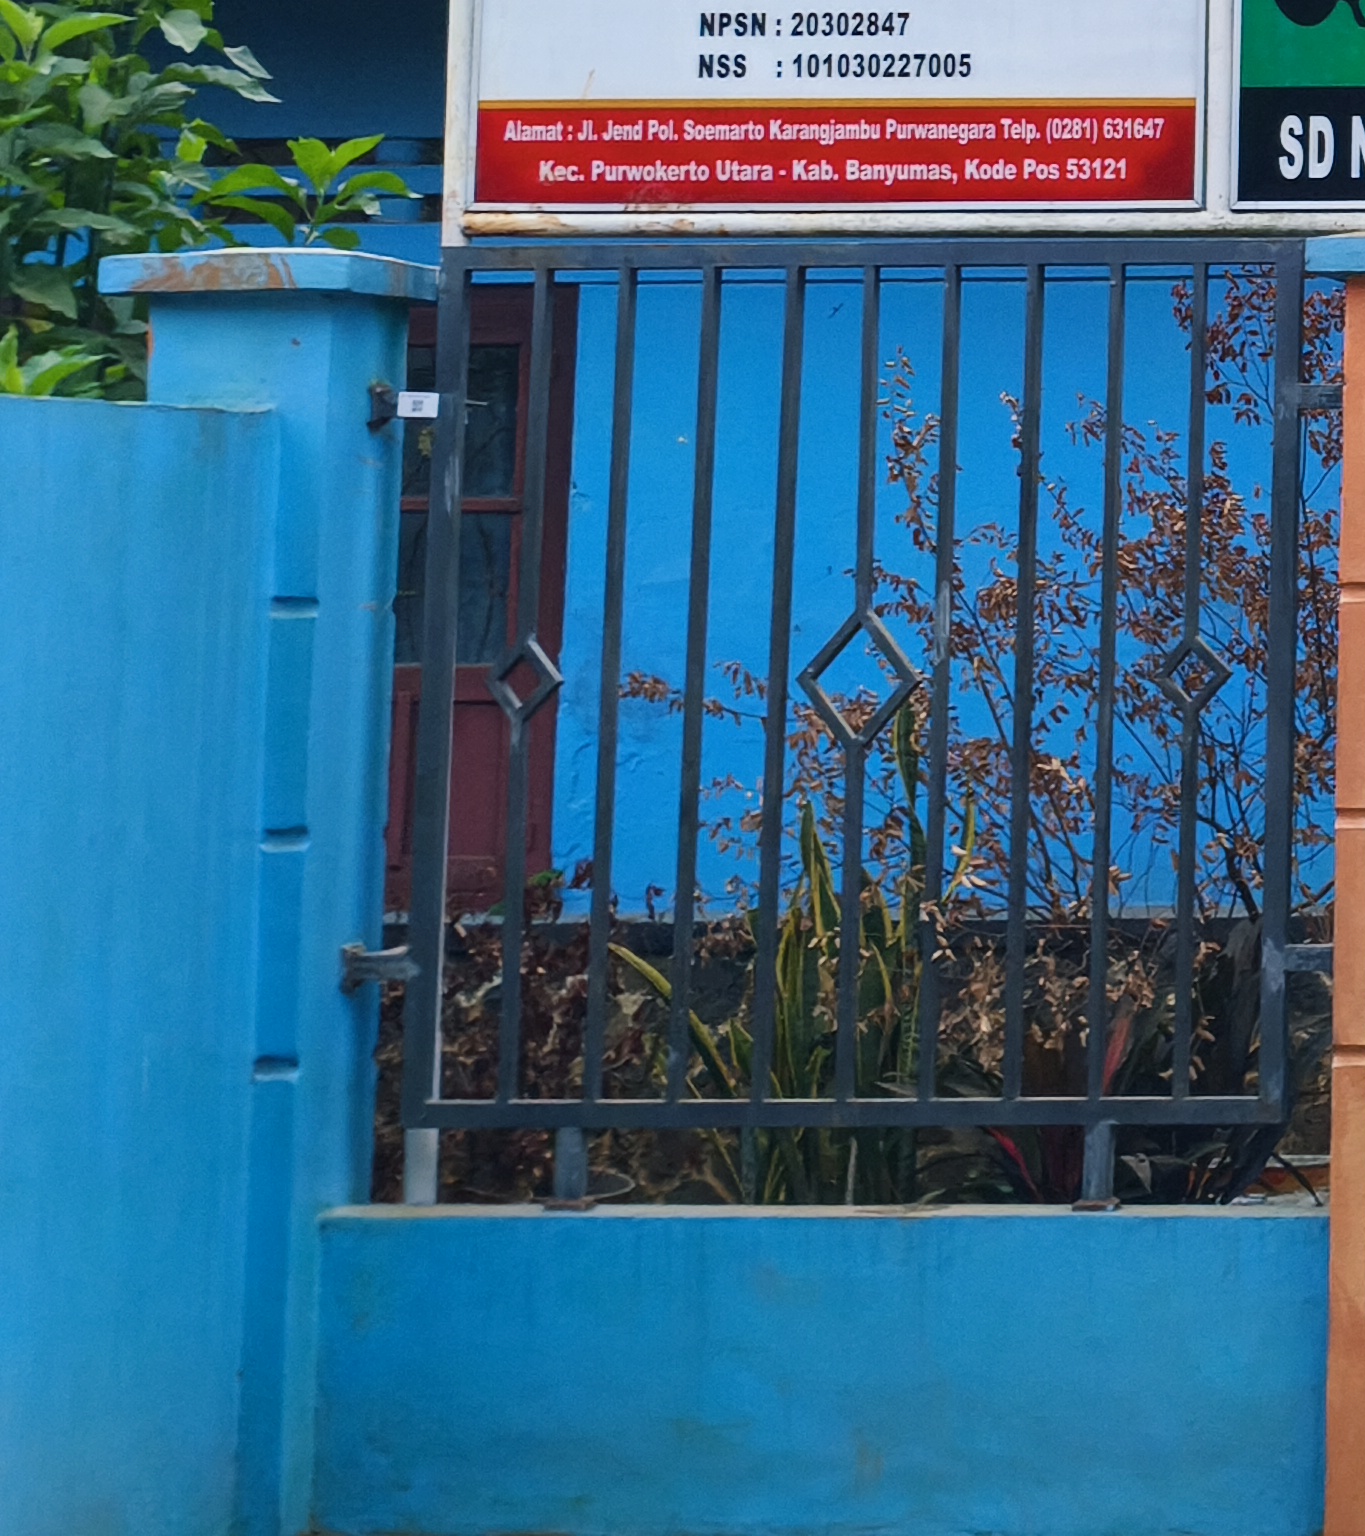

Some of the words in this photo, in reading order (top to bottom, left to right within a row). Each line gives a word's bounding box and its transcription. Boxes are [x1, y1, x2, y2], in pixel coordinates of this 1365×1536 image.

[700, 13, 766, 36] NPSN
[791, 12, 909, 36] 20302847
[699, 54, 746, 78] NSS
[793, 54, 971, 77] 101030227005
[504, 120, 563, 141] Alamat
[578, 120, 597, 140] Jl.
[602, 120, 643, 140] Jend
[648, 120, 678, 140] Pol.
[684, 120, 764, 140] Soemarto
[770, 120, 880, 145] Karangjambu
[886, 119, 995, 144] Purwanegara
[1001, 118, 1040, 144] Telp.
[1046, 118, 1097, 144] (0281)
[1103, 118, 1164, 138] 631647
[1279, 115, 1334, 179] SD
[539, 160, 584, 181] Kec.
[592, 160, 709, 181] Purwokerto
[716, 160, 773, 181] Utara
[793, 160, 838, 180] Kab.
[846, 160, 957, 185] Banyumas,
[965, 159, 1017, 179] Kode
[1024, 159, 1059, 179] Pos
[1066, 158, 1126, 179] 53121
